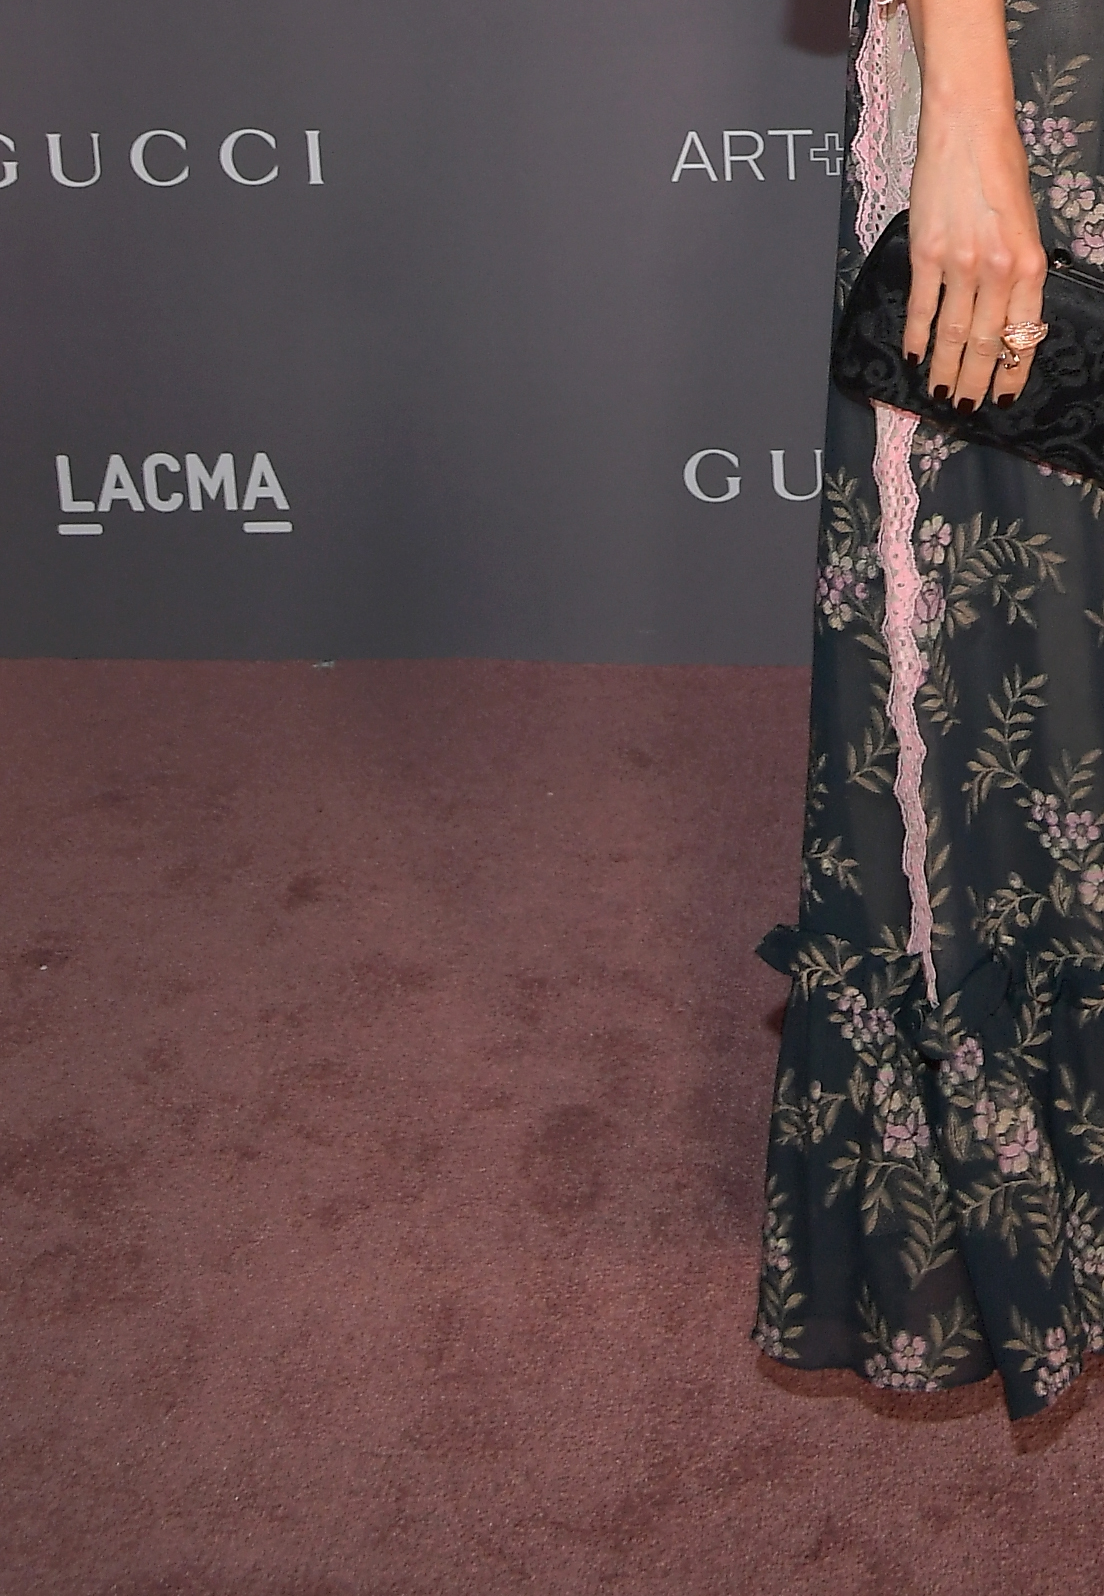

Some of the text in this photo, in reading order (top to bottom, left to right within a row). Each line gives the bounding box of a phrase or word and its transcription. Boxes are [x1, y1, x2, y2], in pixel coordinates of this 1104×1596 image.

[671, 129, 844, 182] ART+
[56, 452, 290, 512] LACMA
[683, 449, 823, 503] GU
